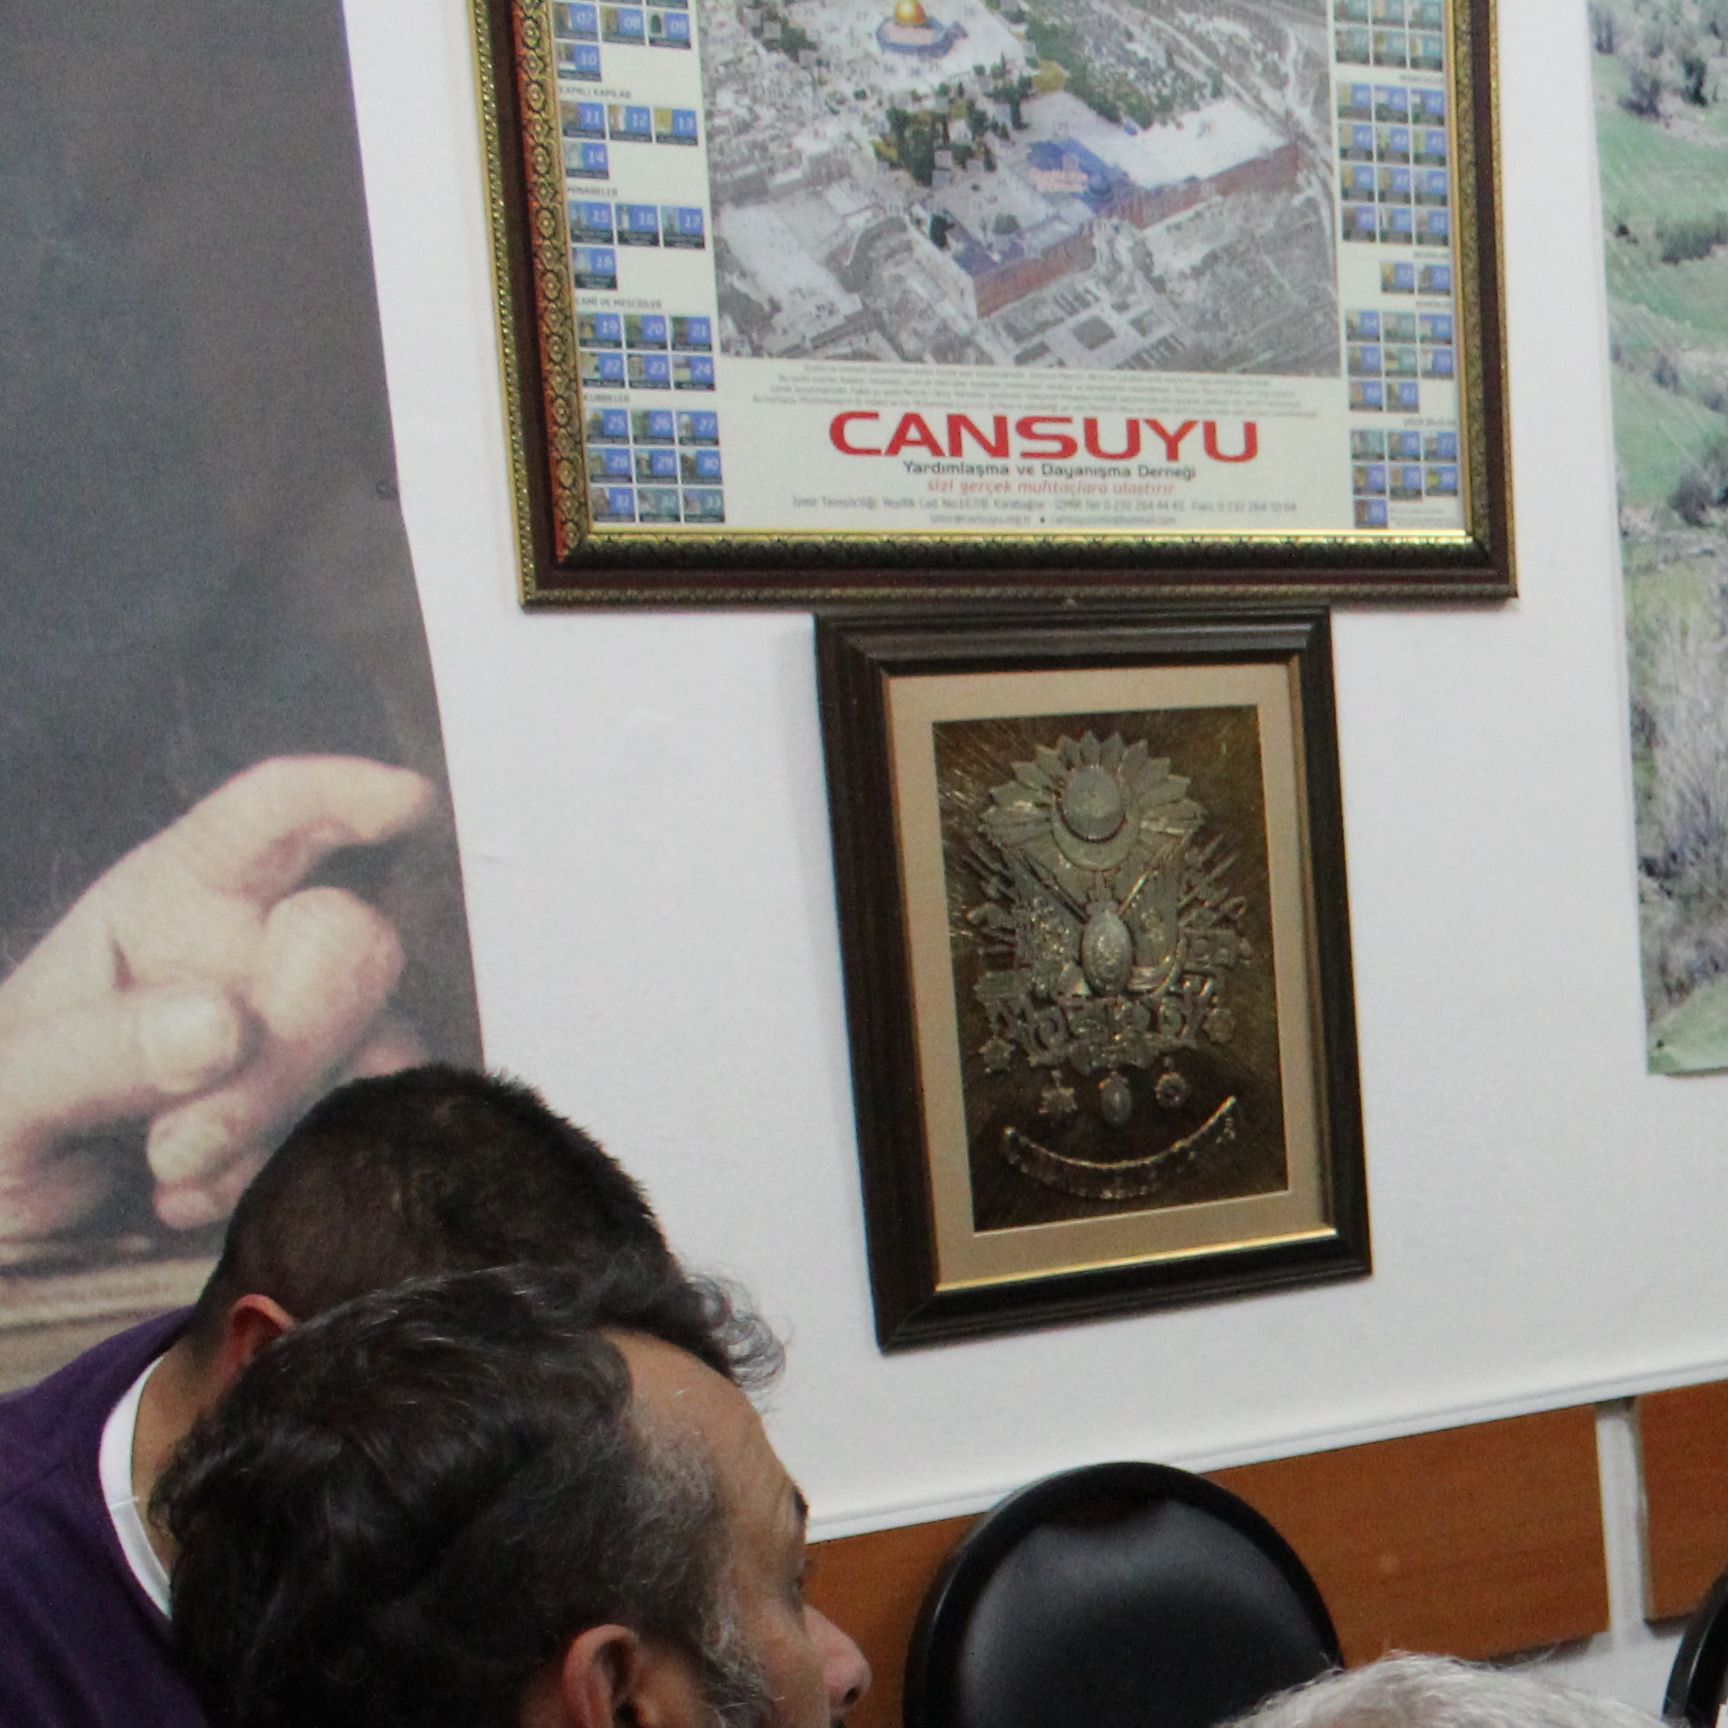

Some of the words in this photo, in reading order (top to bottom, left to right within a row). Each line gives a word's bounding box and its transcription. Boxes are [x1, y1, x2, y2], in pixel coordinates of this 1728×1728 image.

[829, 410, 1258, 463] CANSUYU
[903, 460, 1010, 477] Yardımlaşma
[1016, 464, 1035, 475] ve
[1041, 463, 1131, 479] Dayanışma
[1137, 464, 1196, 480] Derneği
[960, 480, 1012, 495] gerçek
